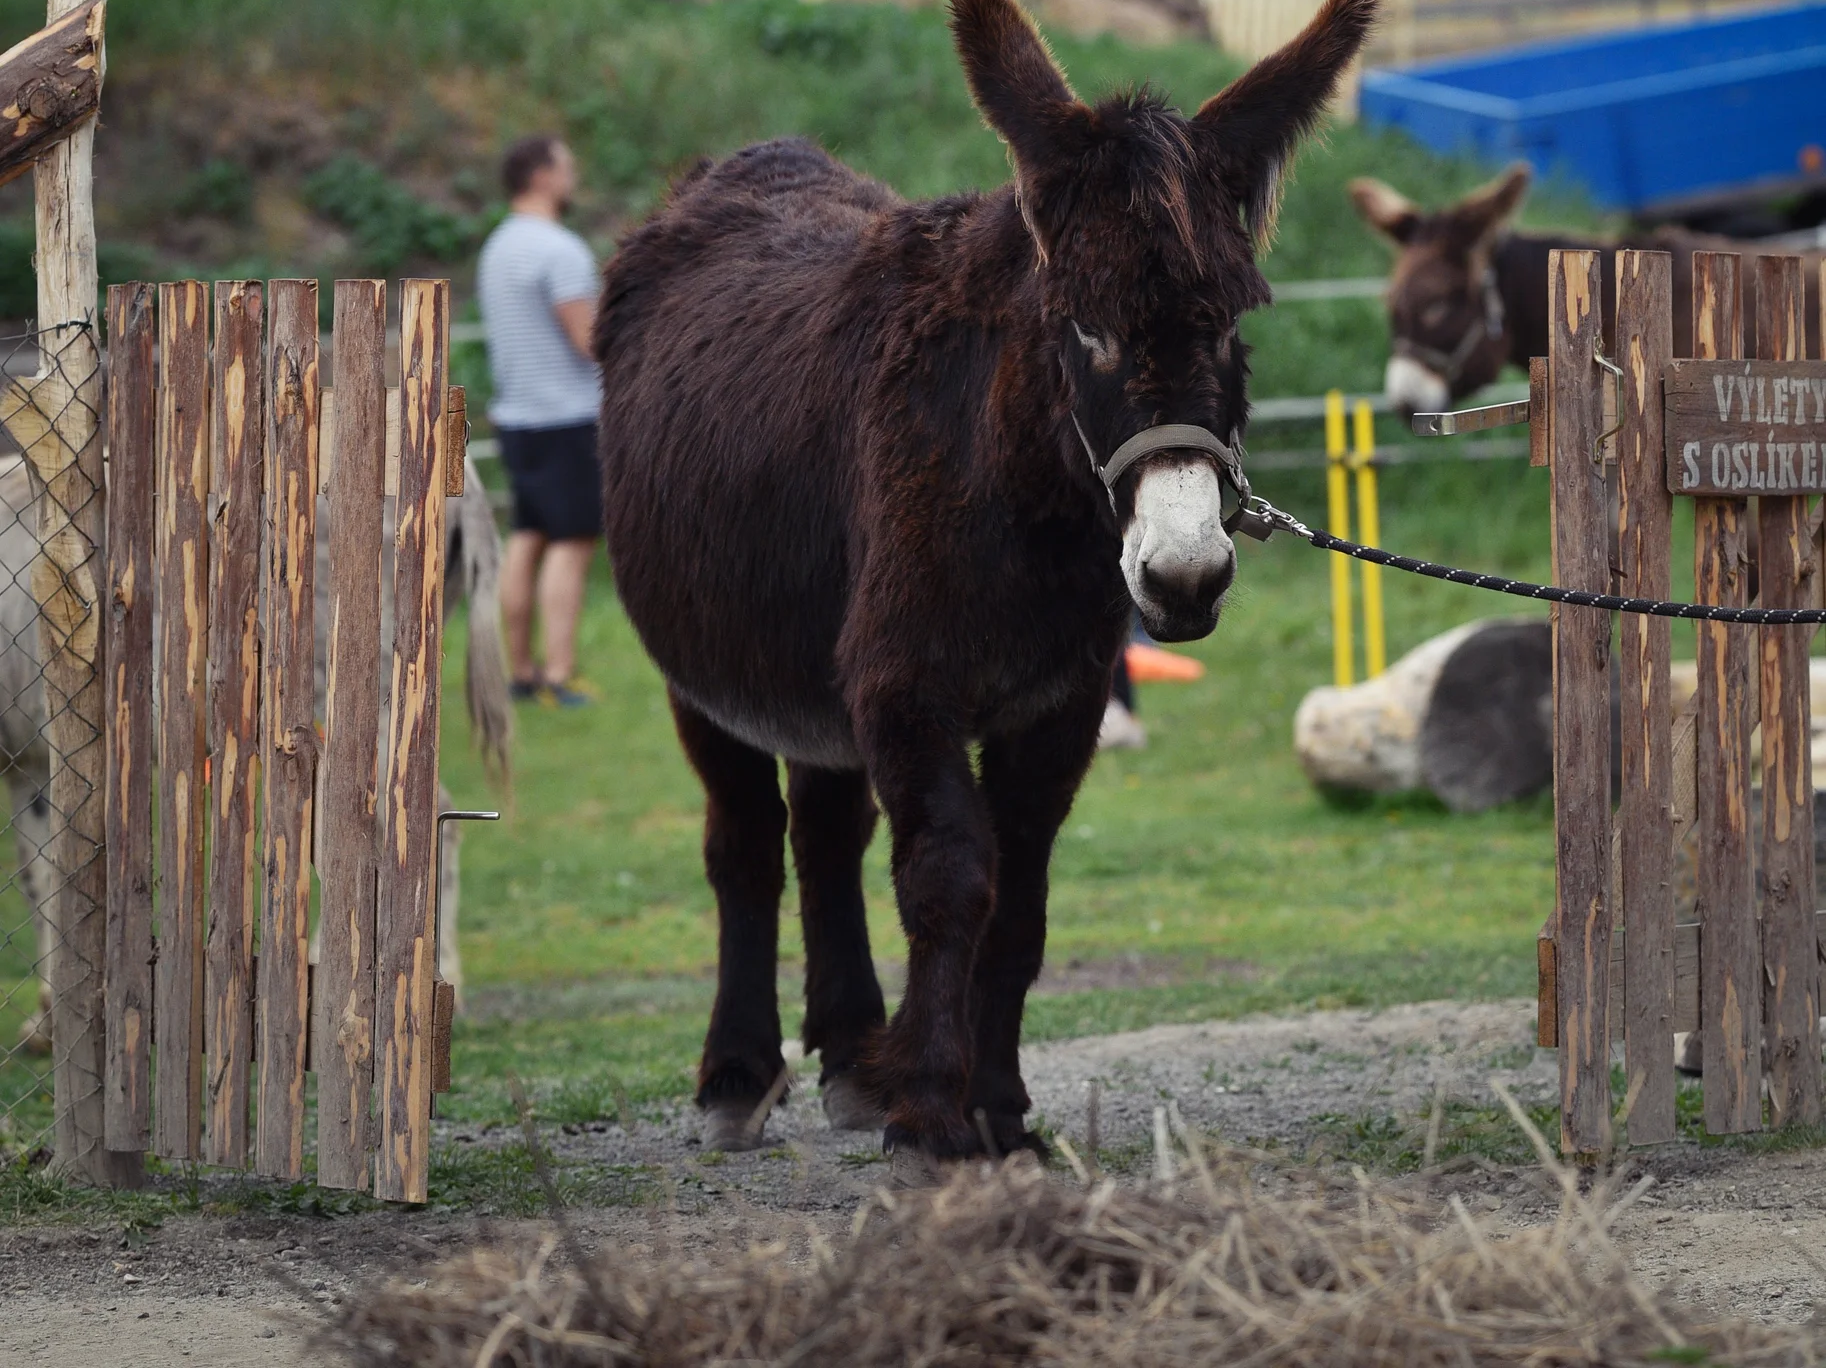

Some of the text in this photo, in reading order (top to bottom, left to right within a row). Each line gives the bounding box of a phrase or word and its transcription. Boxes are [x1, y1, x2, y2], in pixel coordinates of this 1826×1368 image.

[1713, 362, 1826, 425] VÝLETY
[1683, 429, 1826, 490] S OSLÍKE
